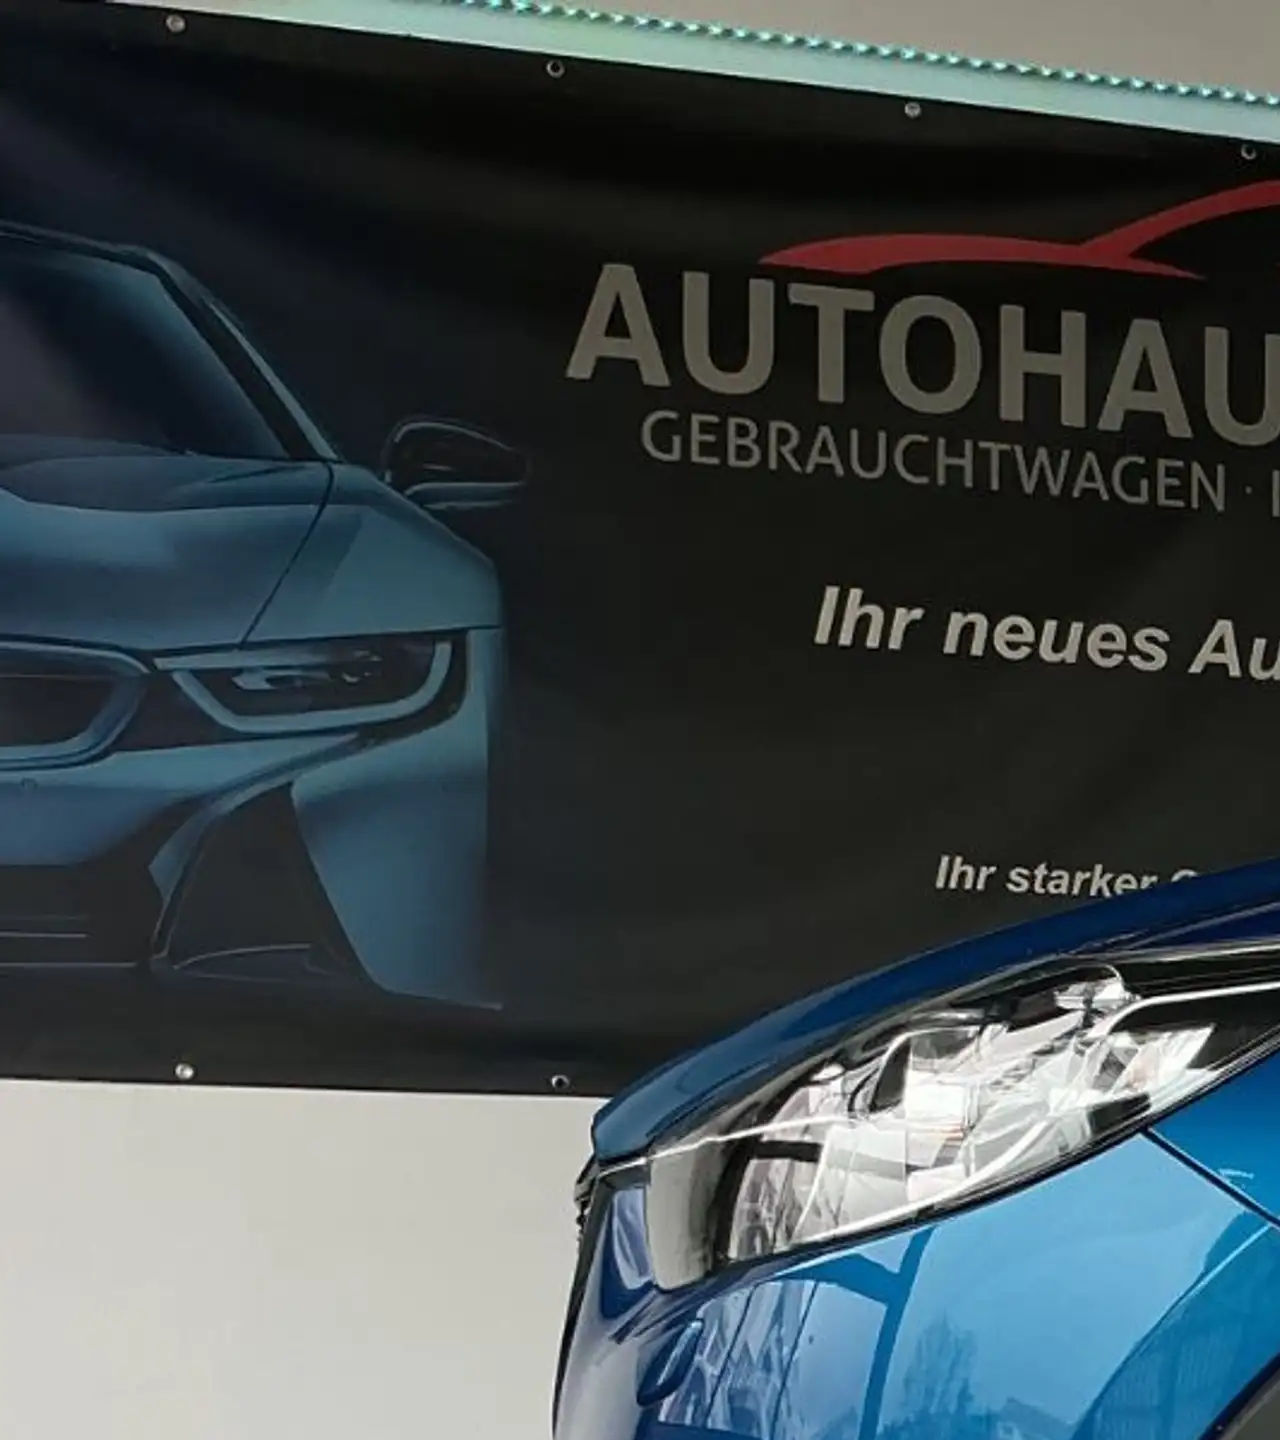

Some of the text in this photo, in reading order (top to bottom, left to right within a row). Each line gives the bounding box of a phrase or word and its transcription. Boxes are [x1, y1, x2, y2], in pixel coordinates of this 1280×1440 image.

[640, 409, 1225, 513] GEBRAUCHTWAGEN
[813, 585, 924, 651] Ihr
[943, 609, 1171, 673] neues
[935, 855, 996, 892] Ihr
